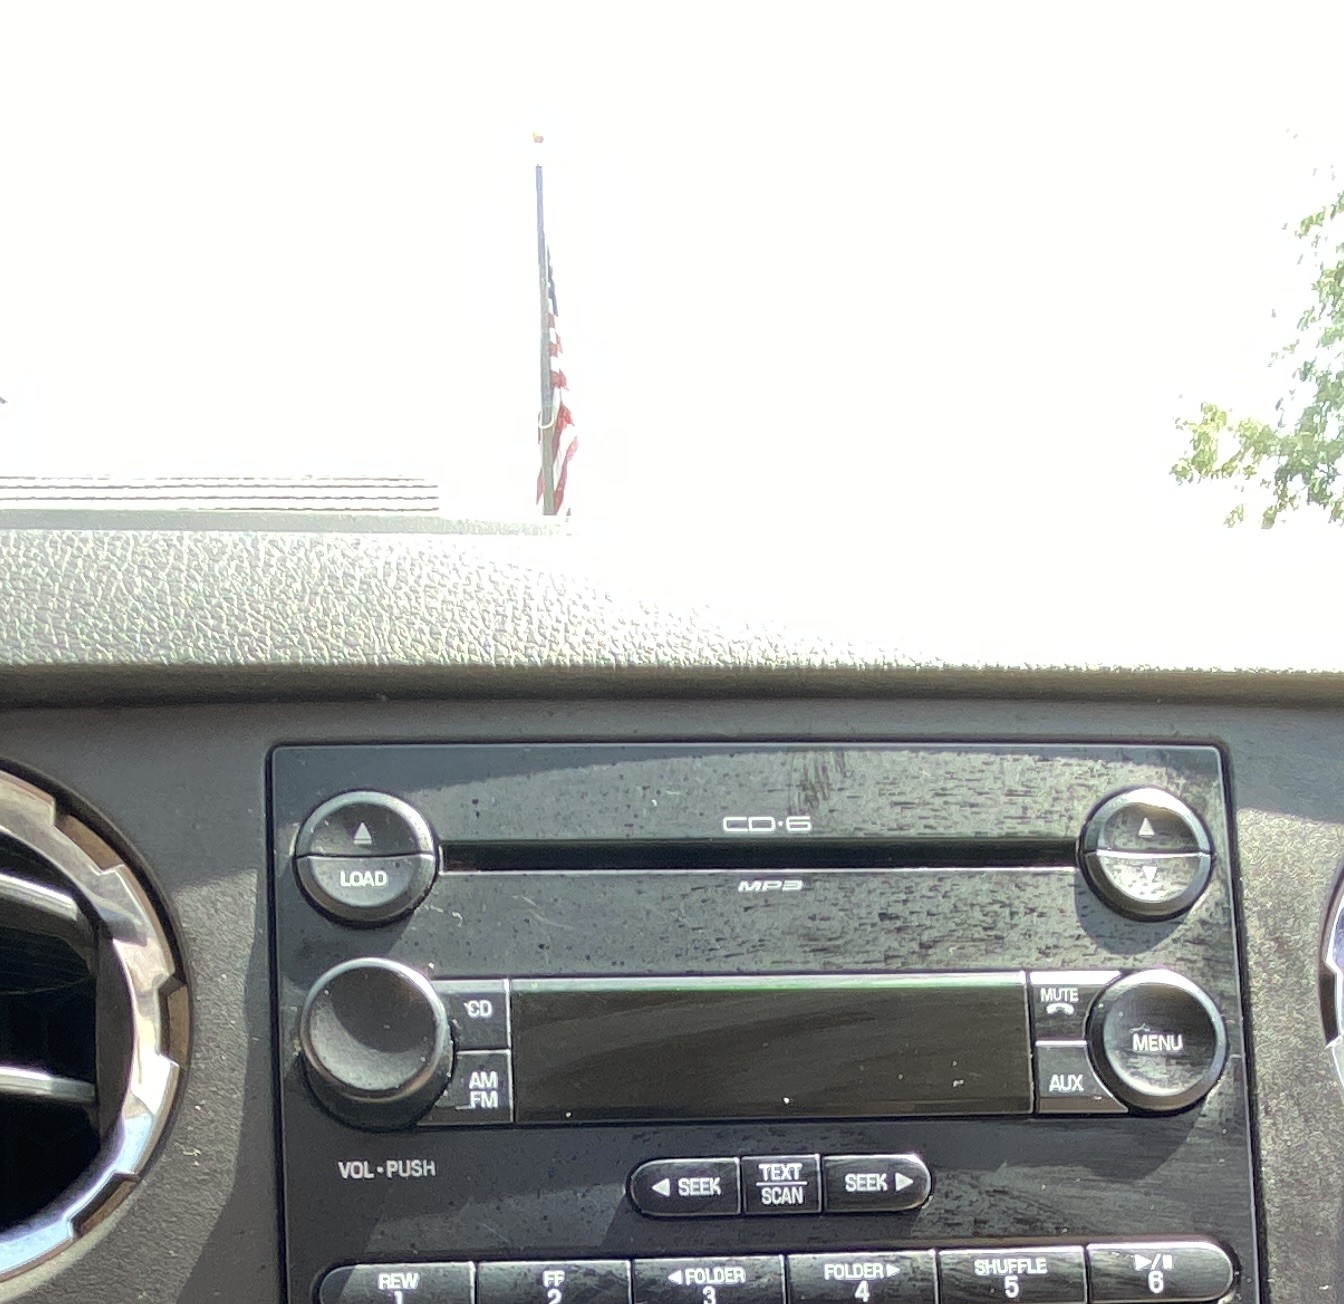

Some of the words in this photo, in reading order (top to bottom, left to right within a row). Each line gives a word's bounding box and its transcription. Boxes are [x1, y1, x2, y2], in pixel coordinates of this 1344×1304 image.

[340, 870, 389, 887] LOAD
[738, 880, 803, 893] MP3
[1040, 987, 1079, 1002] MUTE
[467, 999, 493, 1018] CD
[1132, 1034, 1184, 1051] MENU
[468, 1070, 499, 1090] AM
[1048, 1074, 1085, 1092] AUX
[469, 1090, 499, 1109] FM
[758, 1163, 803, 1181] TEXT
[678, 1176, 721, 1196] SEEK
[845, 1173, 888, 1192] SEEK
[761, 1187, 803, 1206] SCAN
[684, 1266, 746, 1286] FOLDER
[824, 1262, 884, 1281] FOLDER
[974, 1258, 1048, 1276] SHUFFLE
[378, 1273, 419, 1290] REW
[542, 1271, 565, 1287] FF
[1005, 1275, 1020, 1299] 5
[1147, 1270, 1165, 1294] 6
[854, 1281, 871, 1303] 4
